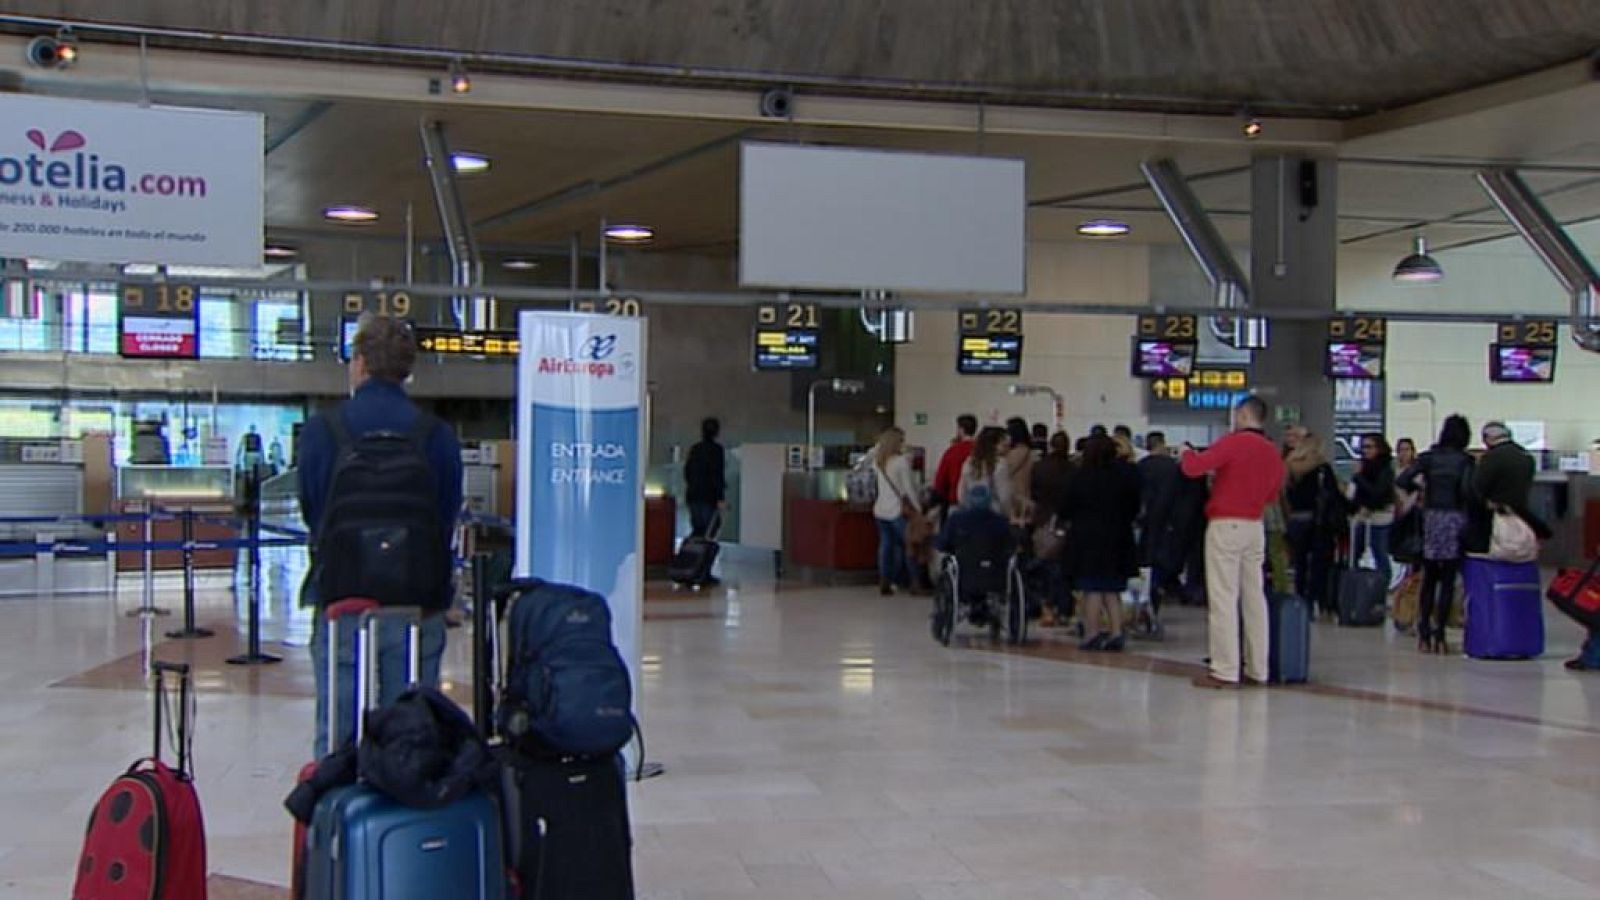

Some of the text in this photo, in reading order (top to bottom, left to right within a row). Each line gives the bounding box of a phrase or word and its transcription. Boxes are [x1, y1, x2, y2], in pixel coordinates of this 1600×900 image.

[58, 195, 126, 212] Holidays
[158, 285, 193, 311] 18
[377, 292, 410, 317] 19
[606, 299, 640, 316] 20
[787, 304, 818, 327] 21
[987, 310, 1018, 331] 22
[1164, 316, 1194, 337] 23
[1354, 319, 1383, 339] 24
[1525, 323, 1554, 342] 25
[551, 442, 626, 457] ENTRADA
[551, 467, 625, 484] ENTRANCE
